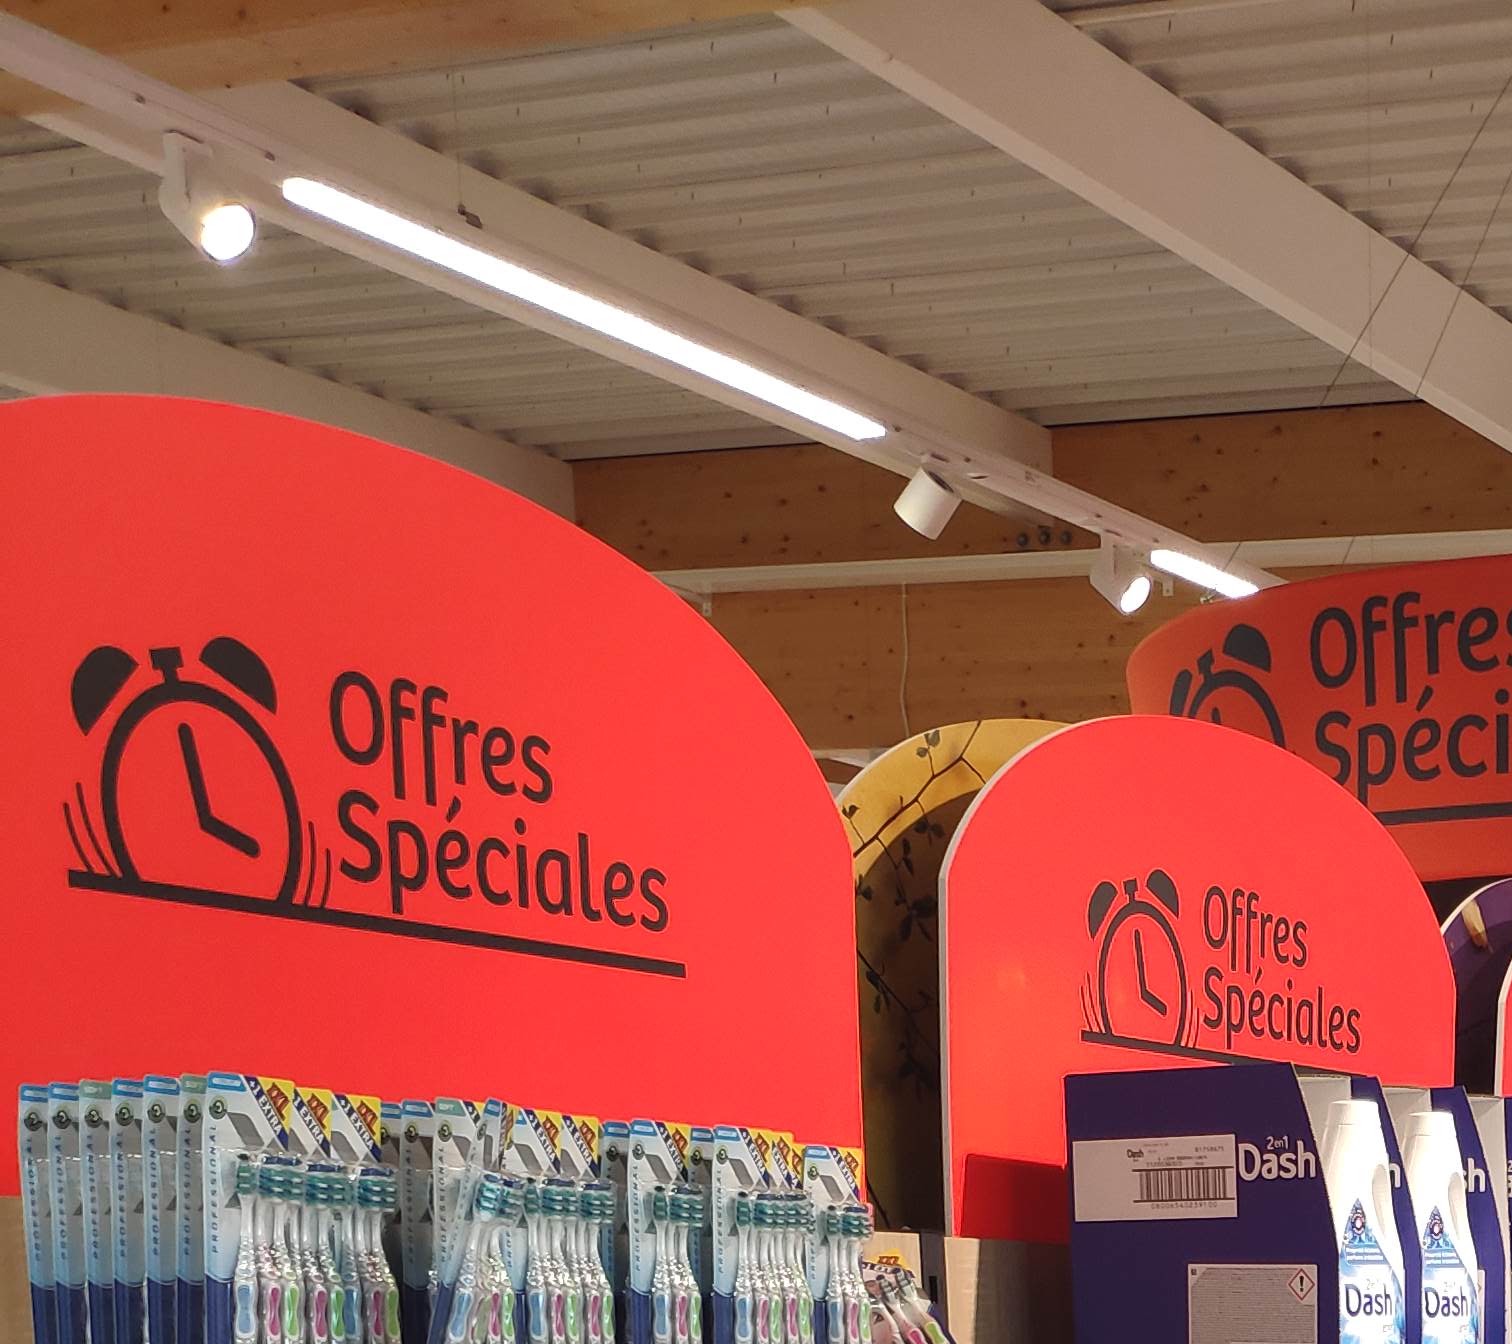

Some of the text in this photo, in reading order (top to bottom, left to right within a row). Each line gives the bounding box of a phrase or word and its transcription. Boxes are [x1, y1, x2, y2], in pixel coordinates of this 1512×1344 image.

[330, 670, 554, 805] Offres
[339, 788, 670, 932] Spéciales
[1203, 884, 1308, 977] Offres
[1202, 969, 1361, 1053] Spéciales
[258, 1097, 283, 1136] EXTRA
[300, 1107, 325, 1146] EXTRA
[351, 1114, 375, 1150] EXTRA
[1126, 1148, 1145, 1160] Dash
[1238, 1140, 1316, 1182] Dash
[1265, 1135, 1290, 1151] 2en1
[1344, 1282, 1393, 1317] Dash
[1424, 1285, 1469, 1319] Dash
